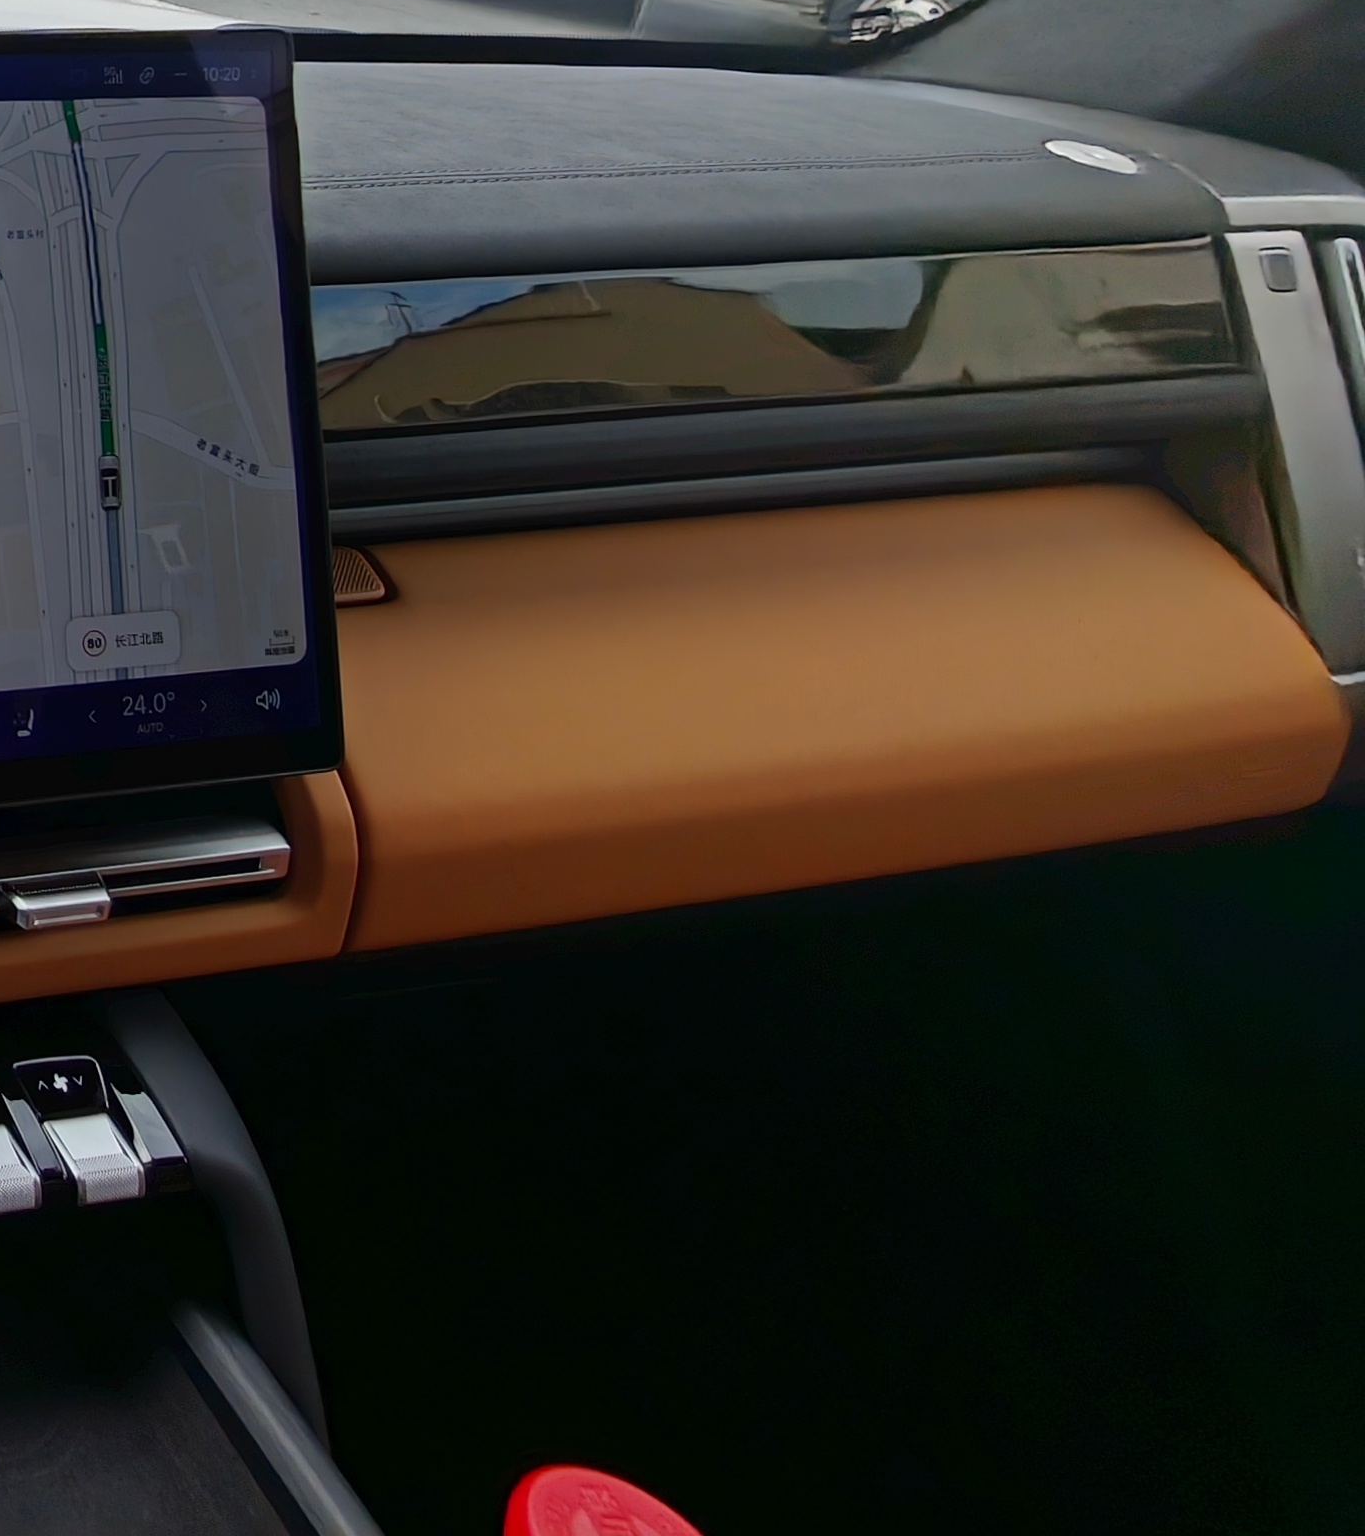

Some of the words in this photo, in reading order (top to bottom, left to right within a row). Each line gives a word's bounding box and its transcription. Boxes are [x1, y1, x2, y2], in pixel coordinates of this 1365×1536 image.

[87, 637, 103, 650] 80
[121, 691, 176, 717] 24.0°
[136, 722, 164, 734] AUTO
